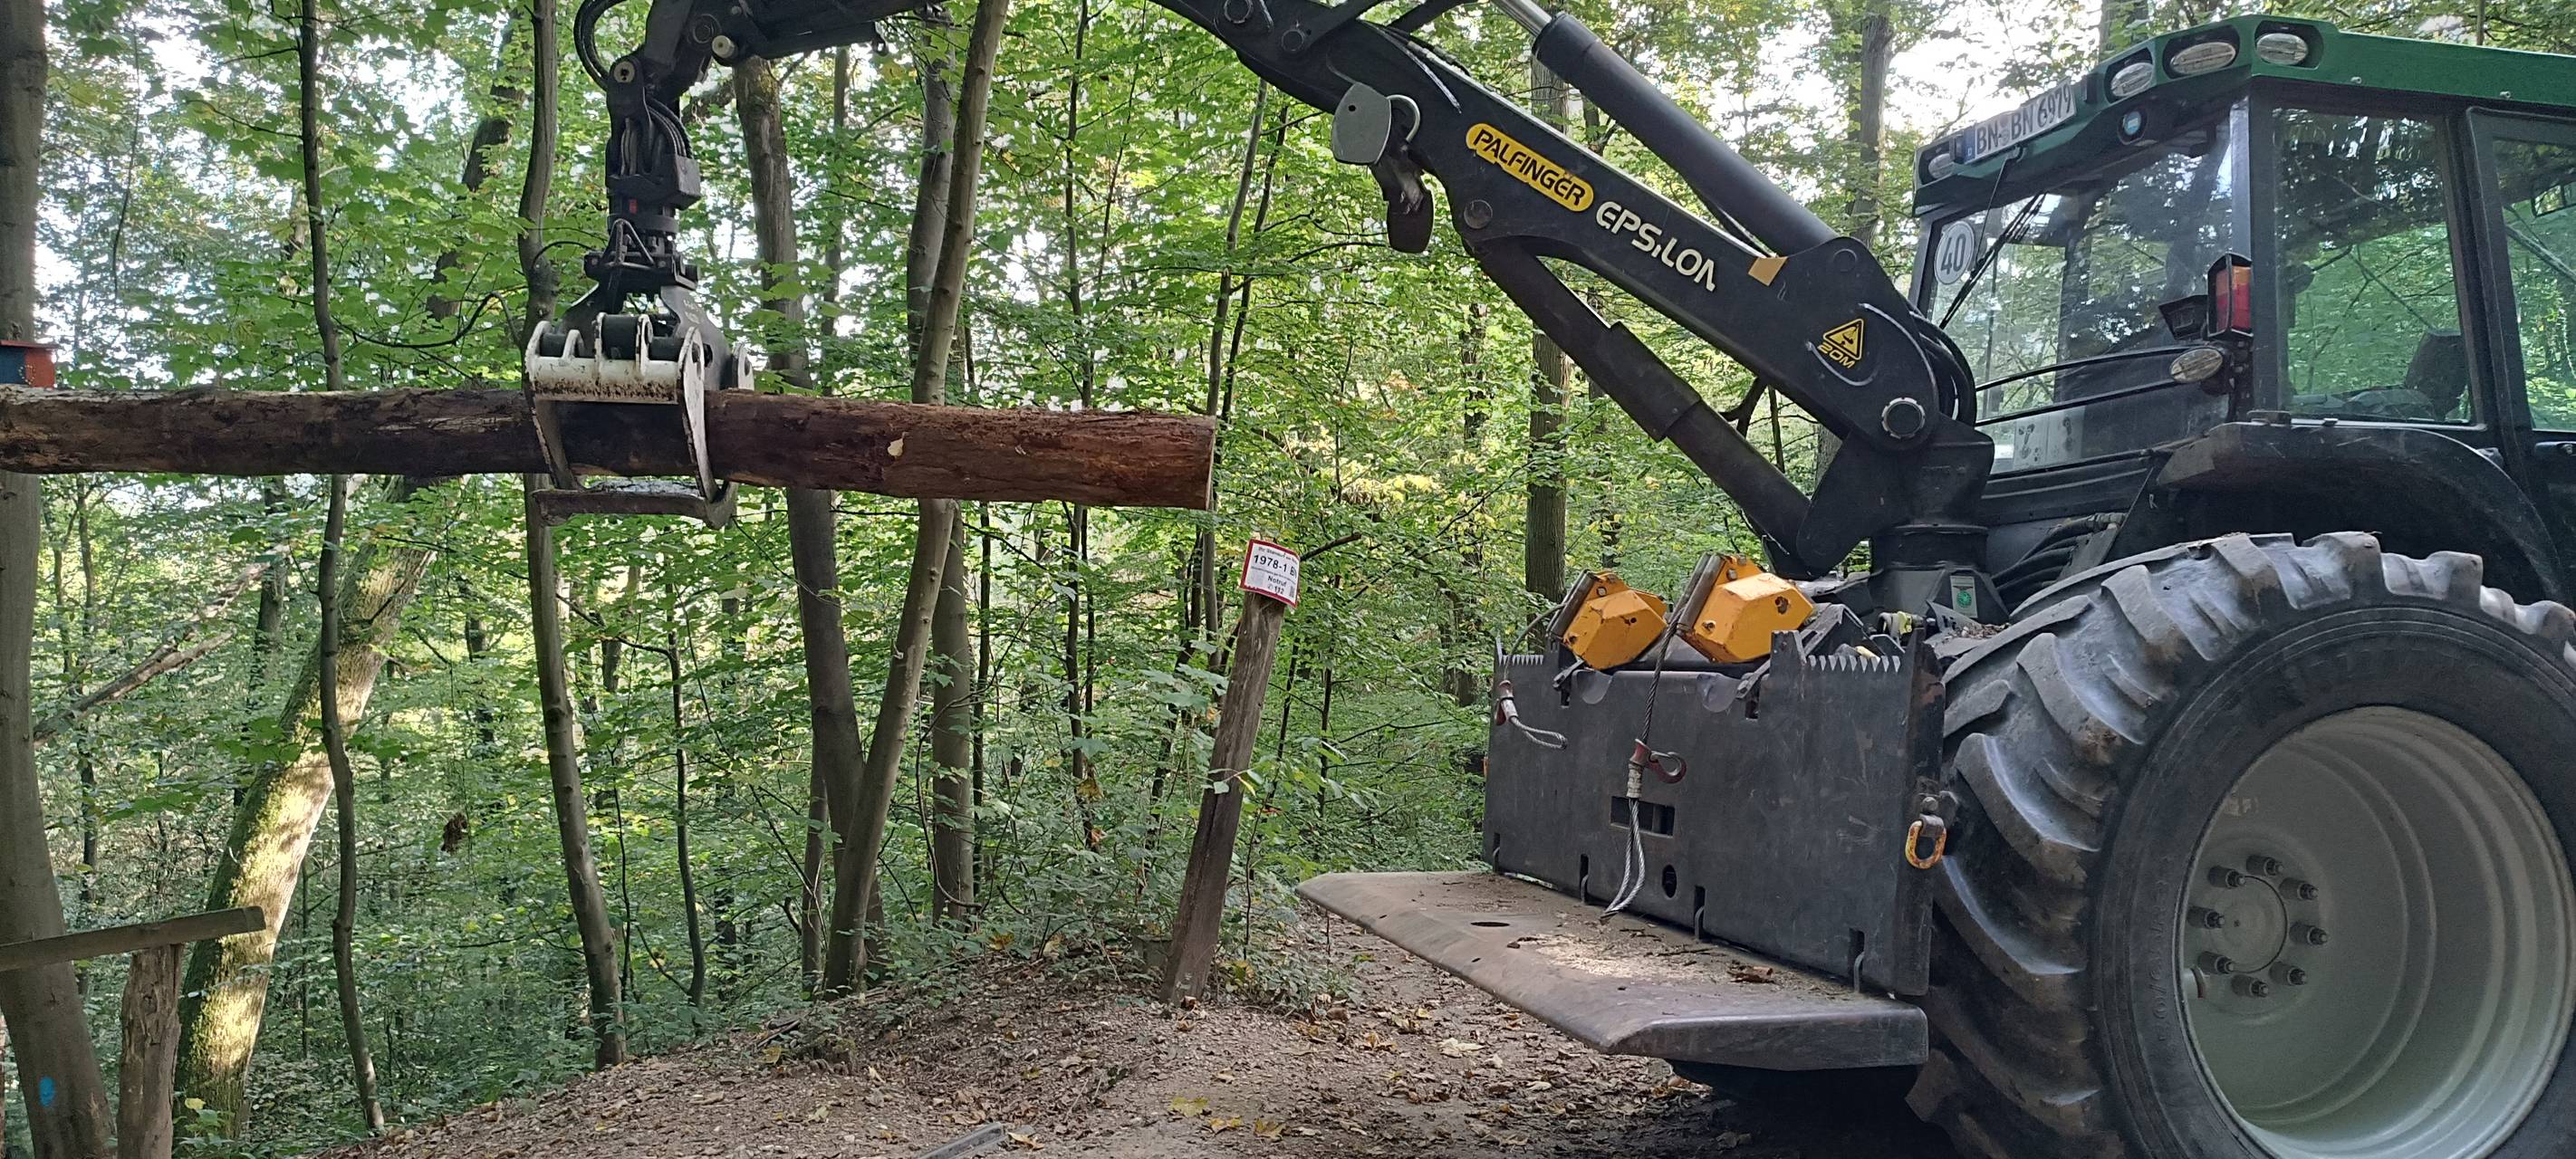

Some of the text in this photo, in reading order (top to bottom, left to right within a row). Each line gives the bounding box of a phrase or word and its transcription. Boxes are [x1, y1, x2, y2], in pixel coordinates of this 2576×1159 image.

[1975, 120, 1999, 156] BN
[2011, 104, 2034, 140] BN
[2037, 82, 2071, 129] 6979
[1473, 129, 1717, 292] PALFINGER EPSILON
[1940, 234, 1966, 275] 40
[1817, 341, 1856, 369] 20M
[1254, 554, 1287, 572] 1978-1
[1268, 575, 1287, 587] Notruf
[1274, 586, 1284, 595] 112
